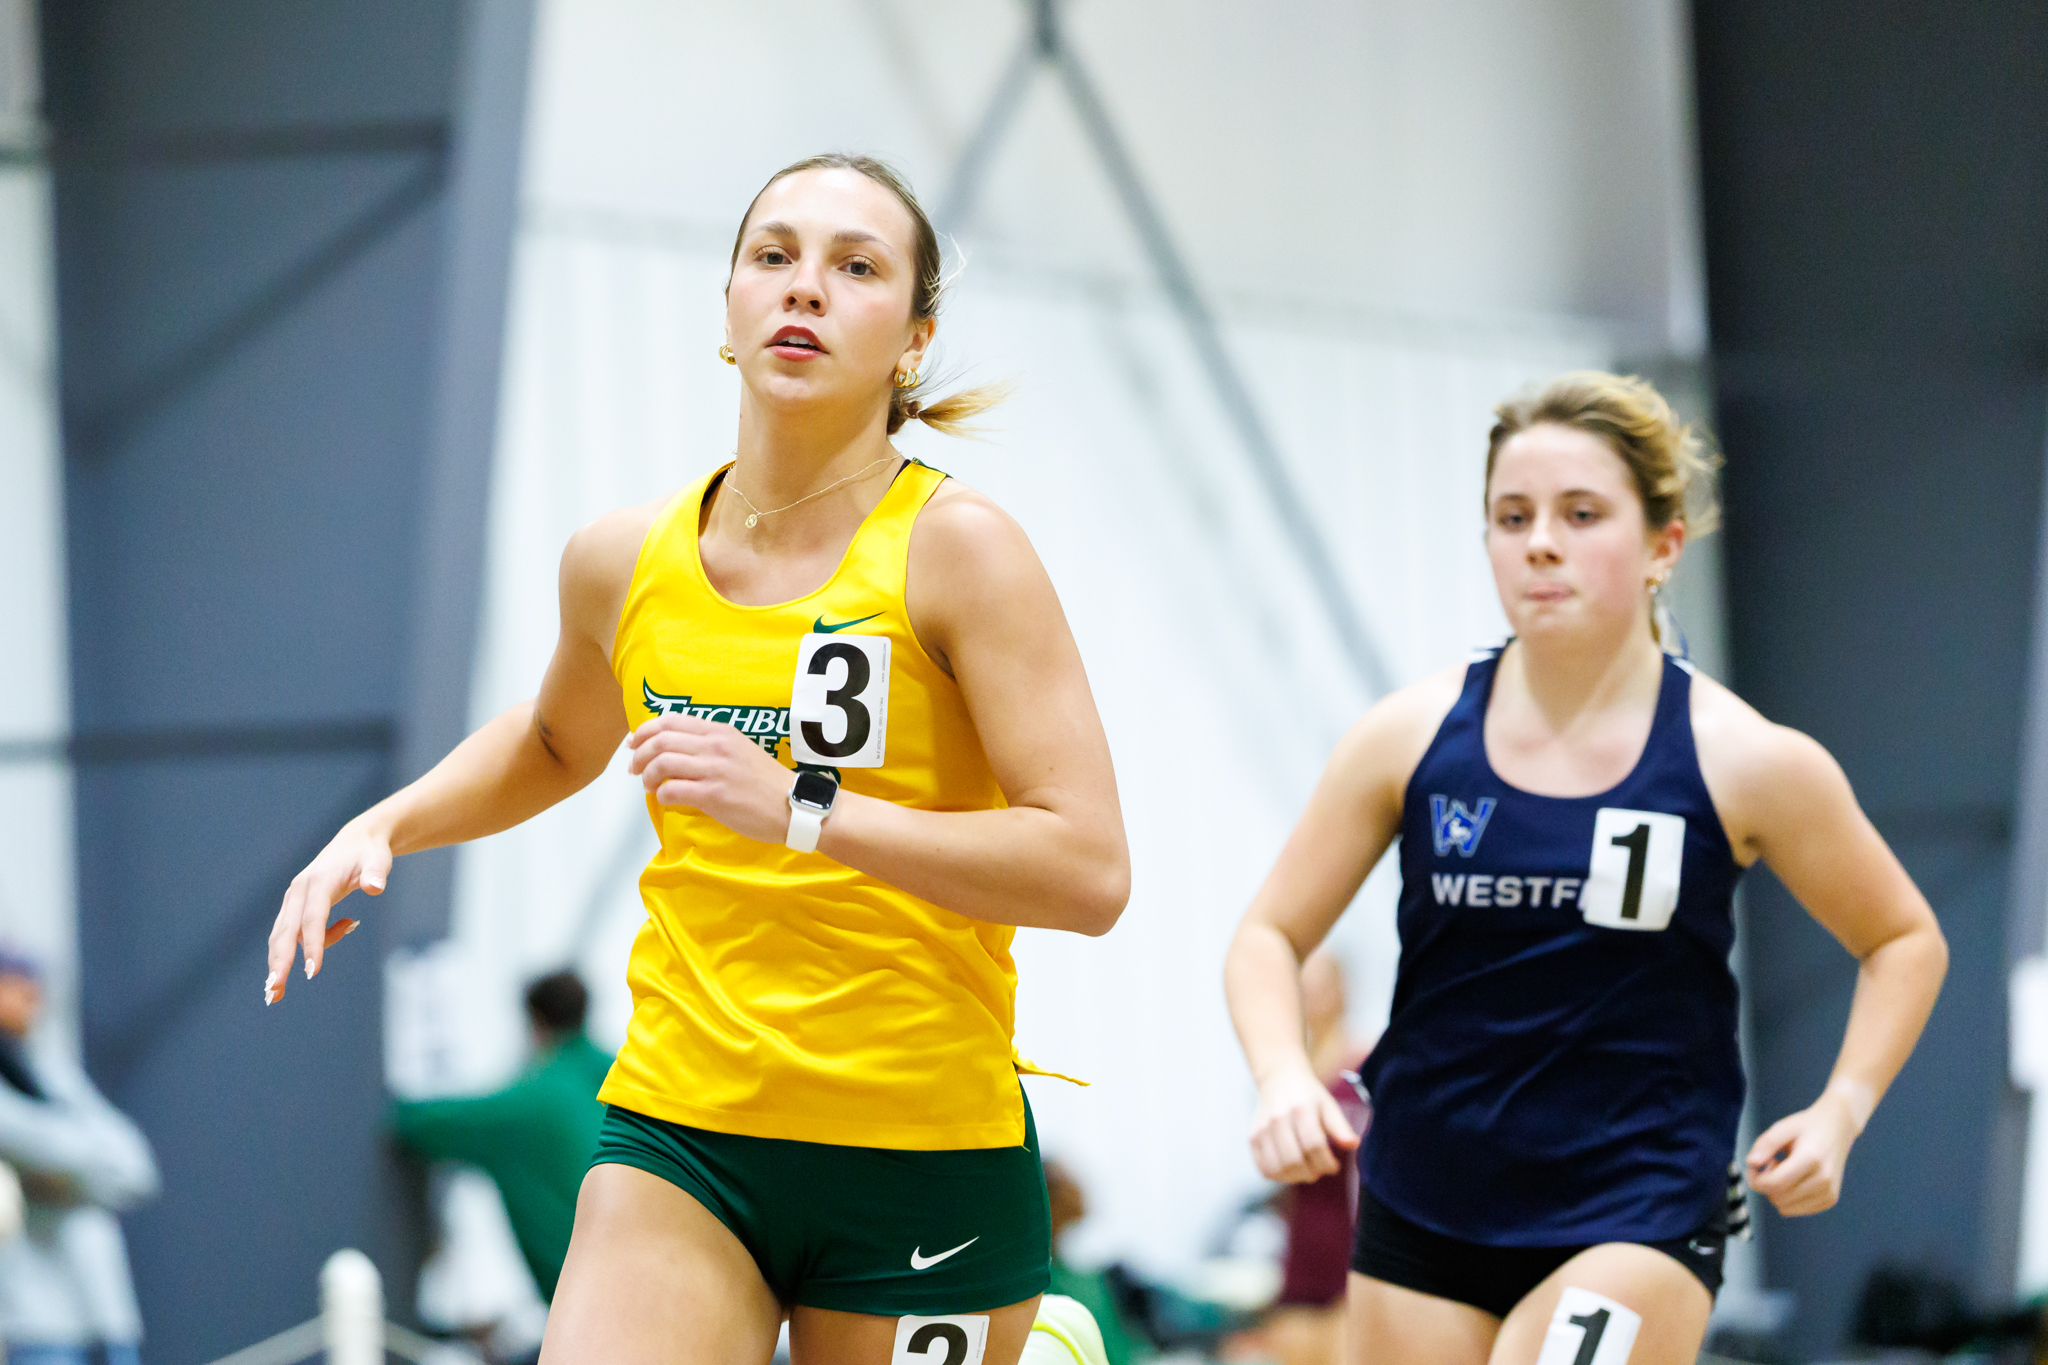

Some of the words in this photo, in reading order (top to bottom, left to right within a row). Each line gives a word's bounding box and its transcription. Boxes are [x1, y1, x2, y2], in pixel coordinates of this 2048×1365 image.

[800, 643, 871, 758] 3
[1429, 794, 1497, 858] W
[1611, 824, 1650, 919] 1
[1569, 1307, 1612, 1365] 1
